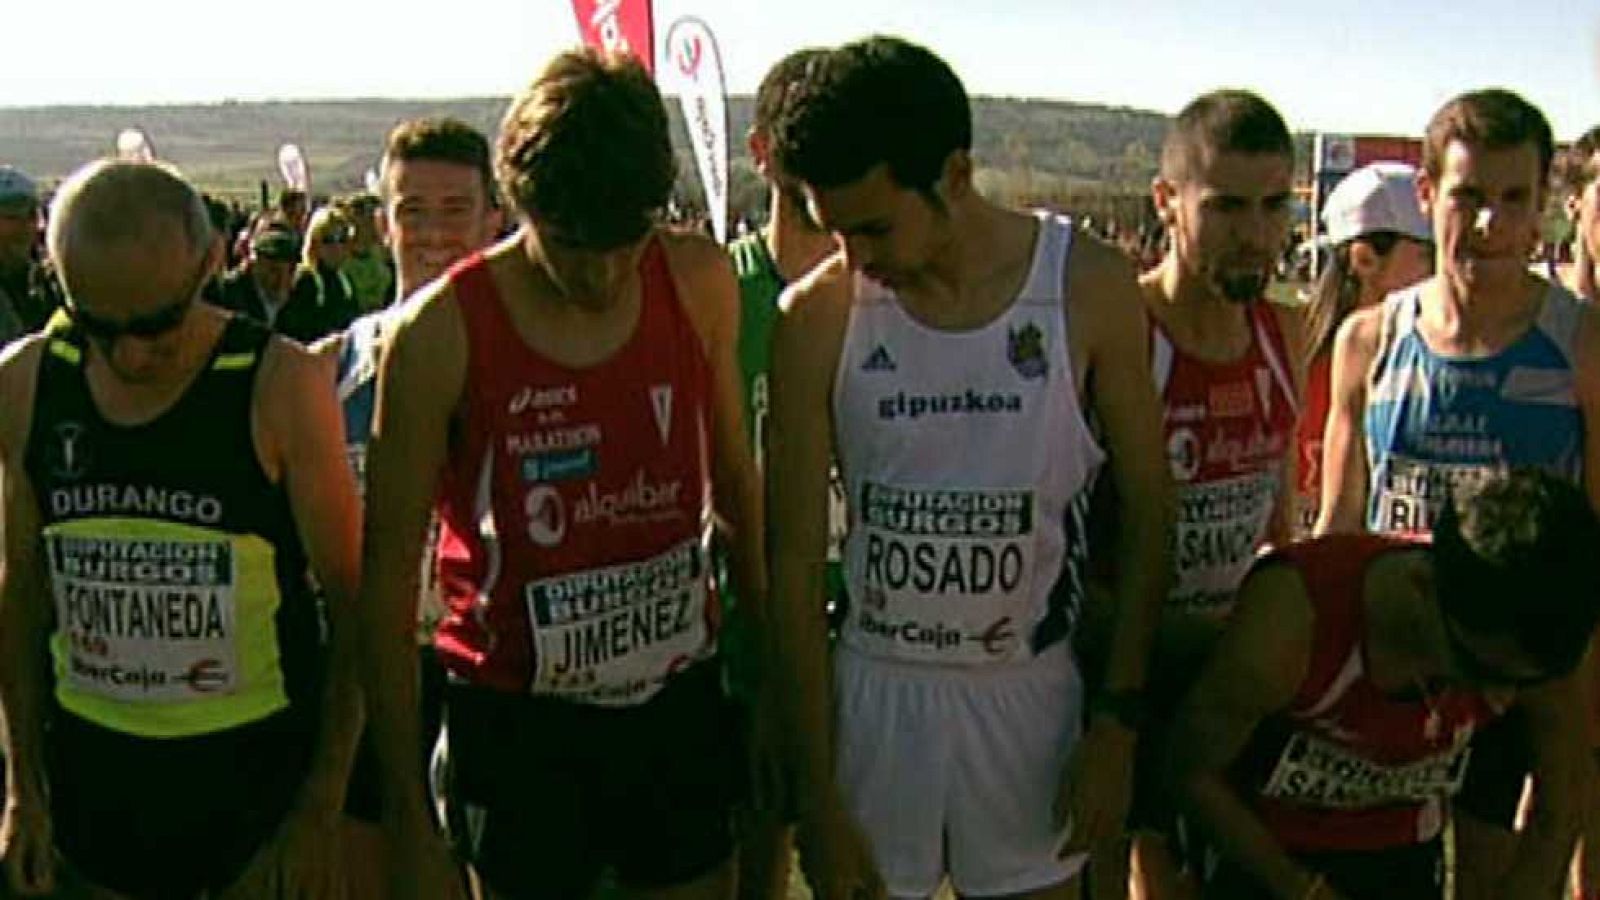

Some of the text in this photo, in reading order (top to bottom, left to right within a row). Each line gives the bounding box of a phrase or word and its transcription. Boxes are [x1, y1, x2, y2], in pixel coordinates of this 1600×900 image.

[878, 388, 1022, 419] gipuzkoa
[52, 483, 223, 523] DURANGO
[865, 533, 1023, 595] ROSADO
[64, 582, 225, 638] FONTANEDA
[554, 592, 692, 674] JIMENEZ
